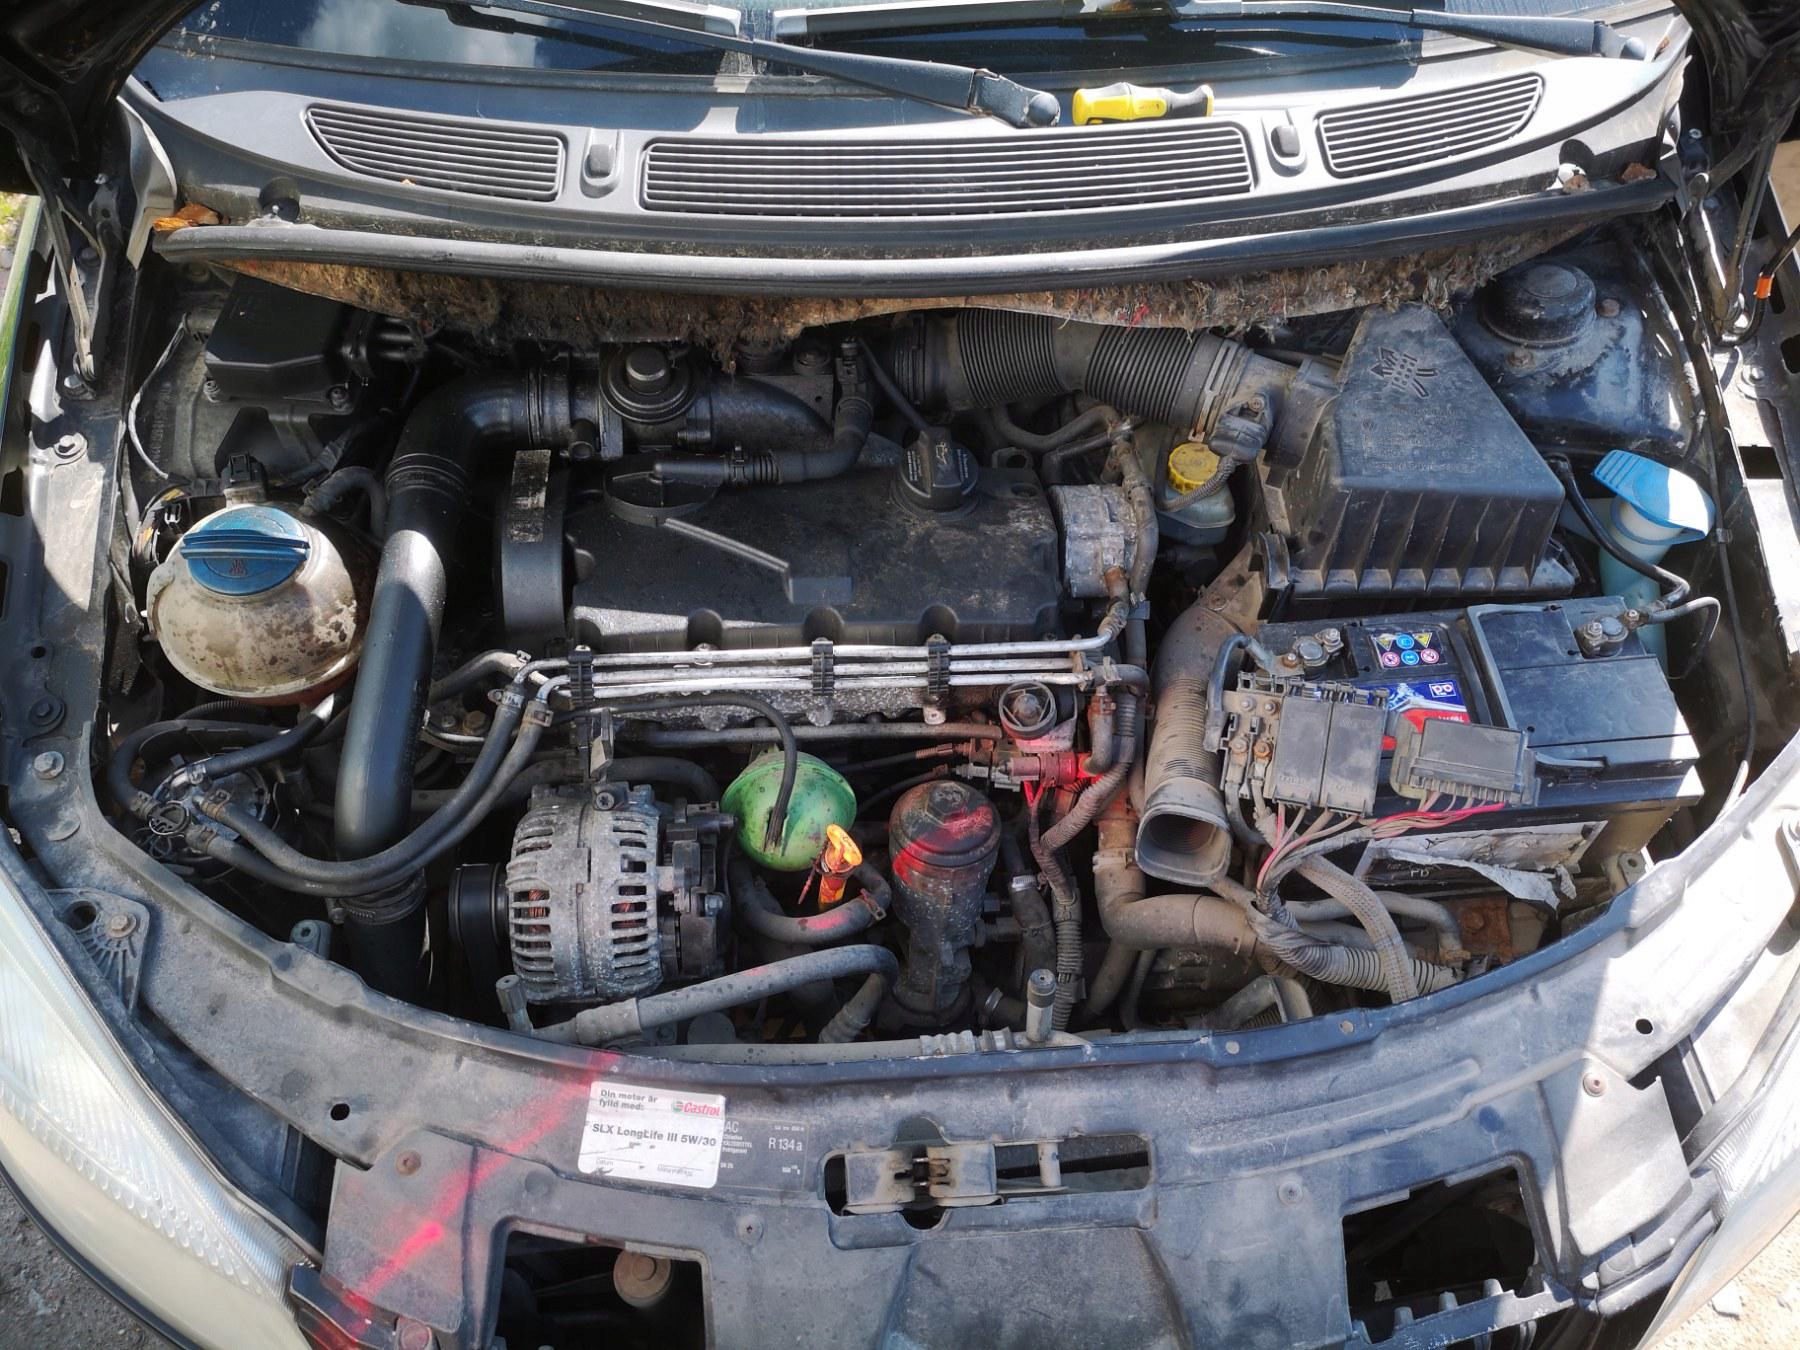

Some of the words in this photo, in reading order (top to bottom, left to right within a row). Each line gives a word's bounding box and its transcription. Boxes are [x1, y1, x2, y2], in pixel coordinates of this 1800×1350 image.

[600, 1089, 616, 1099] Din
[619, 1092, 645, 1102] motor
[648, 1095, 659, 1104] är
[599, 1099, 618, 1109] fylld
[621, 1101, 645, 1111] med:
[683, 1102, 721, 1117] Castrol
[592, 1123, 614, 1135] SLX
[617, 1126, 664, 1141] LongLife
[667, 1132, 678, 1143] III
[681, 1134, 717, 1147] 5W/30
